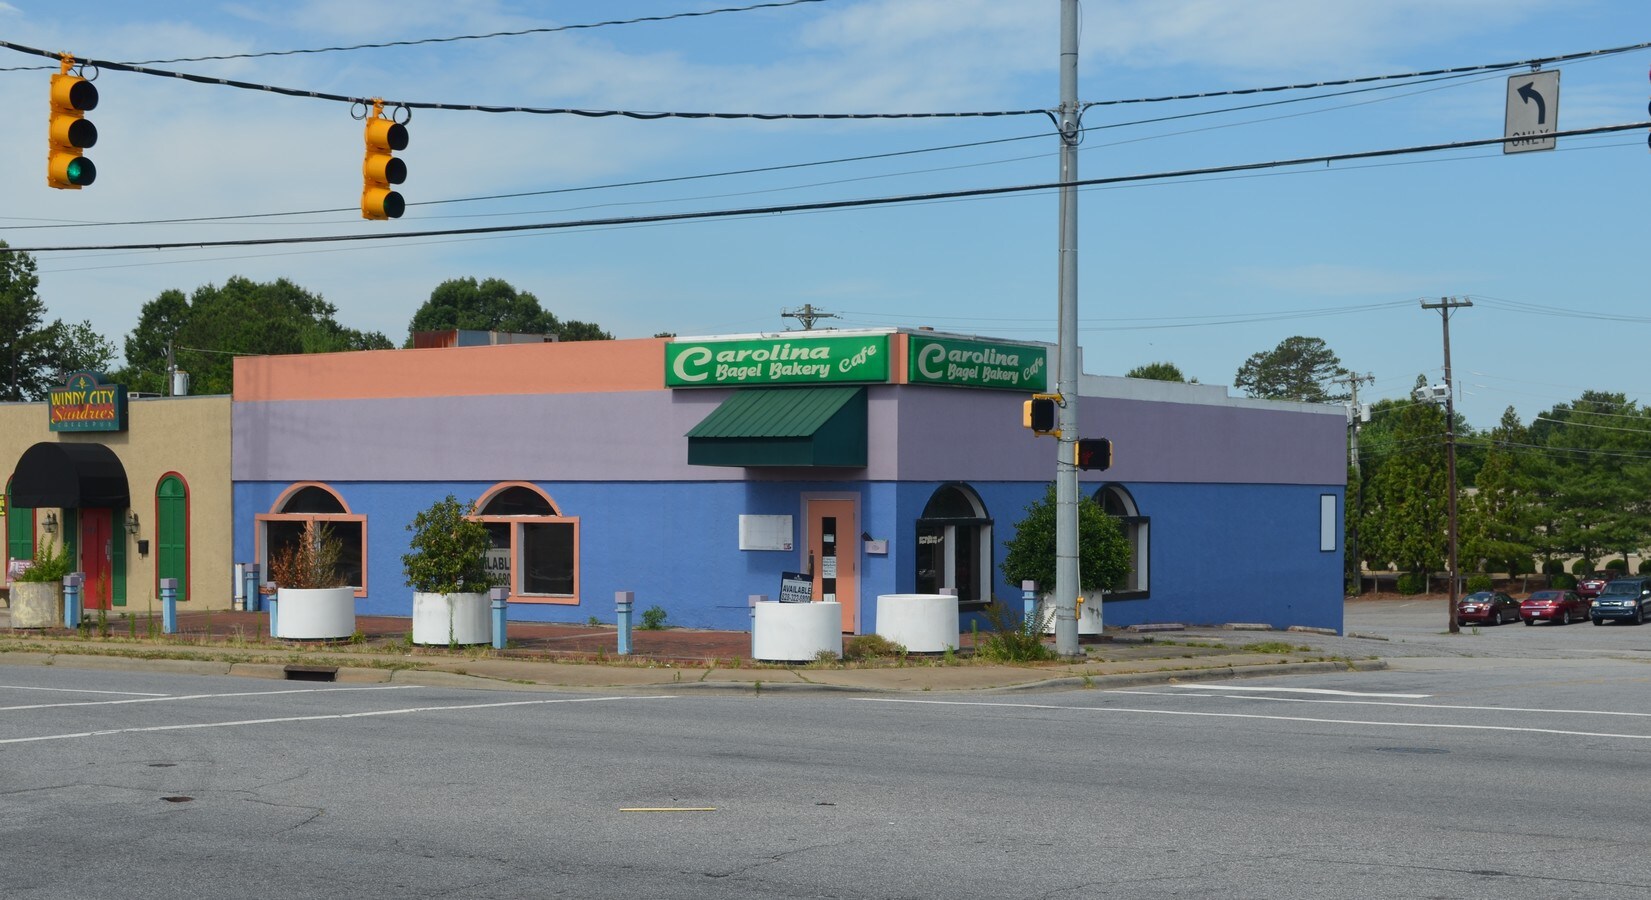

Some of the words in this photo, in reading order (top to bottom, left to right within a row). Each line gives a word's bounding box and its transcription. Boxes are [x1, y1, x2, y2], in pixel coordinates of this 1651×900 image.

[1512, 129, 1549, 147] ONLY
[673, 343, 830, 382] Carolina
[838, 345, 877, 373] Cafe
[918, 343, 1019, 379] Carolina
[1023, 357, 1044, 381] Cafe
[715, 363, 762, 381] Bagel
[769, 362, 831, 380] Bakery
[947, 363, 979, 381] Bagel
[982, 366, 1019, 384] Bakery
[51, 390, 86, 406] WINDY
[89, 390, 115, 405] CITY
[783, 584, 812, 595] AVAILABLE
